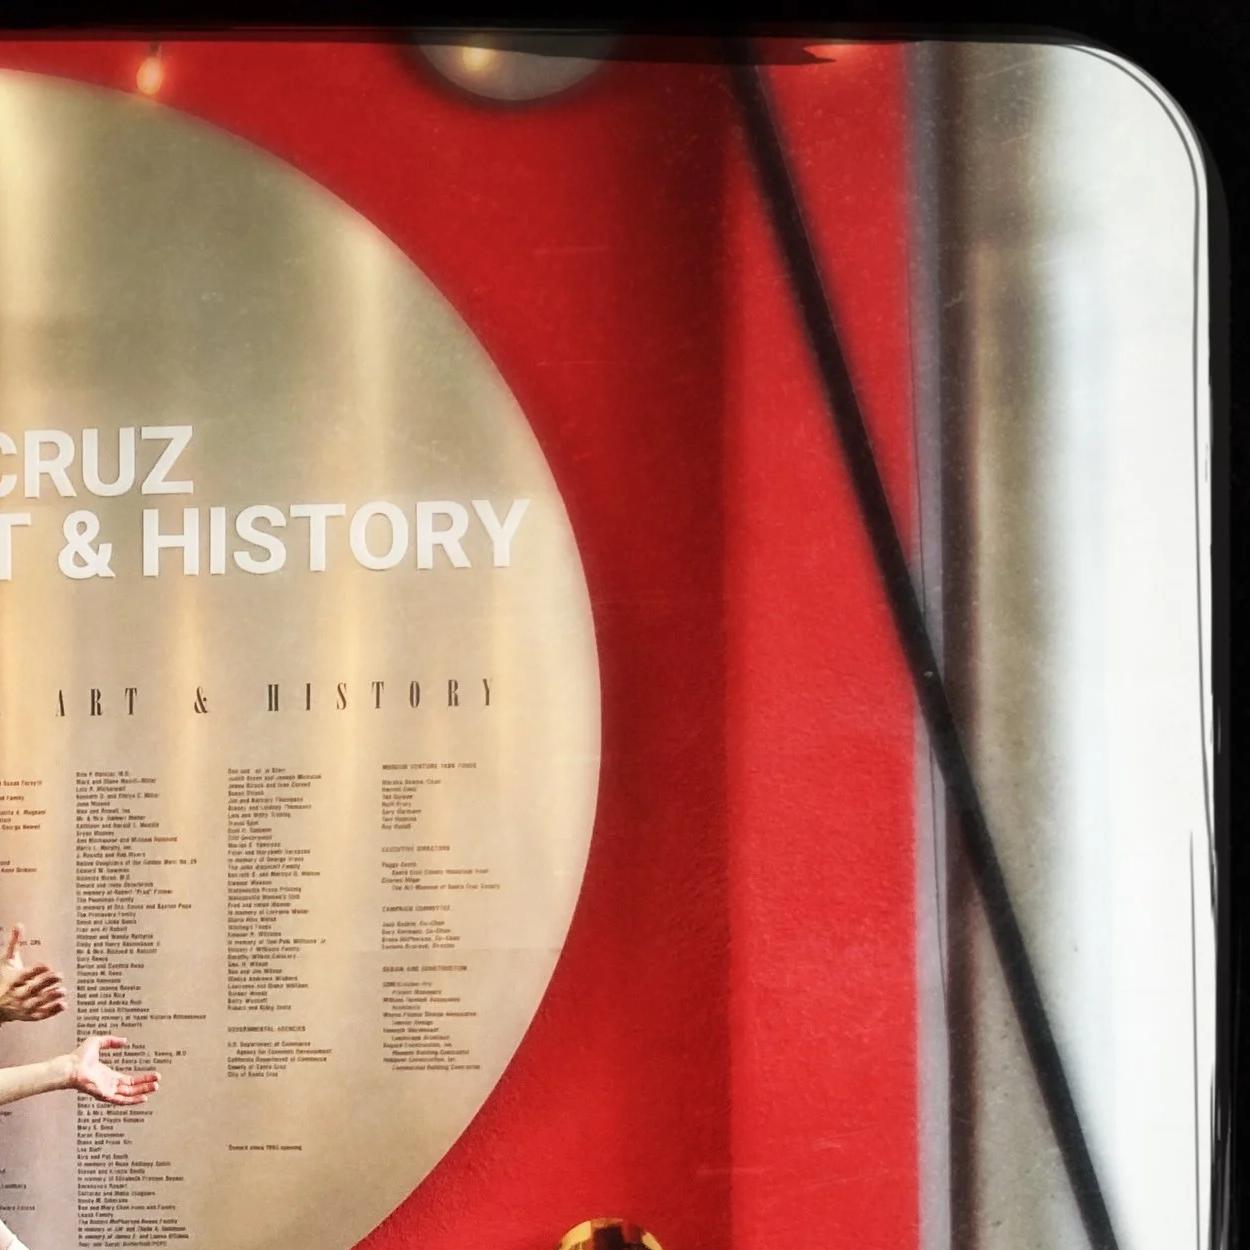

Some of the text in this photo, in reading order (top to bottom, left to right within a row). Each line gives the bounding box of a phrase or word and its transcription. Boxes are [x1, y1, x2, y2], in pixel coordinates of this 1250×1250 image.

[58, 510, 115, 579] &
[143, 499, 531, 577] HISTORY
[55, 686, 138, 717] ART
[193, 686, 209, 714] &
[267, 678, 493, 712] HISTORY
